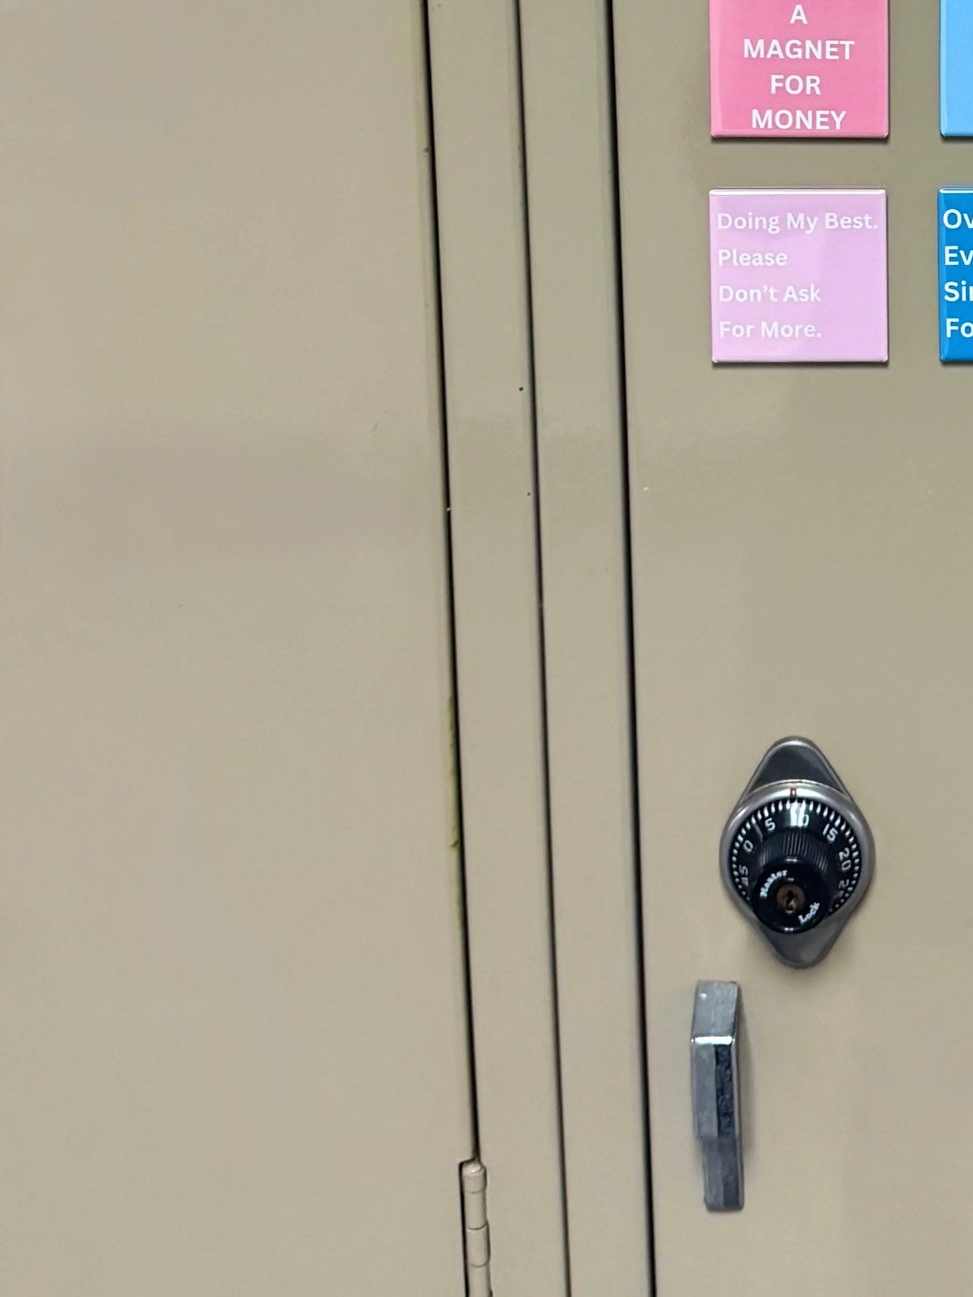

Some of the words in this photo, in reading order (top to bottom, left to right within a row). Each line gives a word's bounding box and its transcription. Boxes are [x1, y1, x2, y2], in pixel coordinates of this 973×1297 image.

[790, 5, 807, 24] A
[744, 39, 855, 59] MAGNET
[771, 75, 820, 94] FOR
[752, 109, 846, 130] MONEY
[717, 212, 780, 234] Doing
[787, 213, 818, 234] My
[825, 213, 878, 230] Best.
[719, 249, 787, 266] Please
[719, 285, 777, 302] Don’t
[783, 284, 820, 302] Ask
[719, 321, 754, 338] For
[761, 321, 821, 338] More.
[764, 817, 776, 831] 5
[823, 823, 838, 842] 15
[743, 840, 754, 853] 0
[839, 848, 852, 871] 20
[760, 870, 788, 899] Master
[798, 902, 820, 925] Lock
